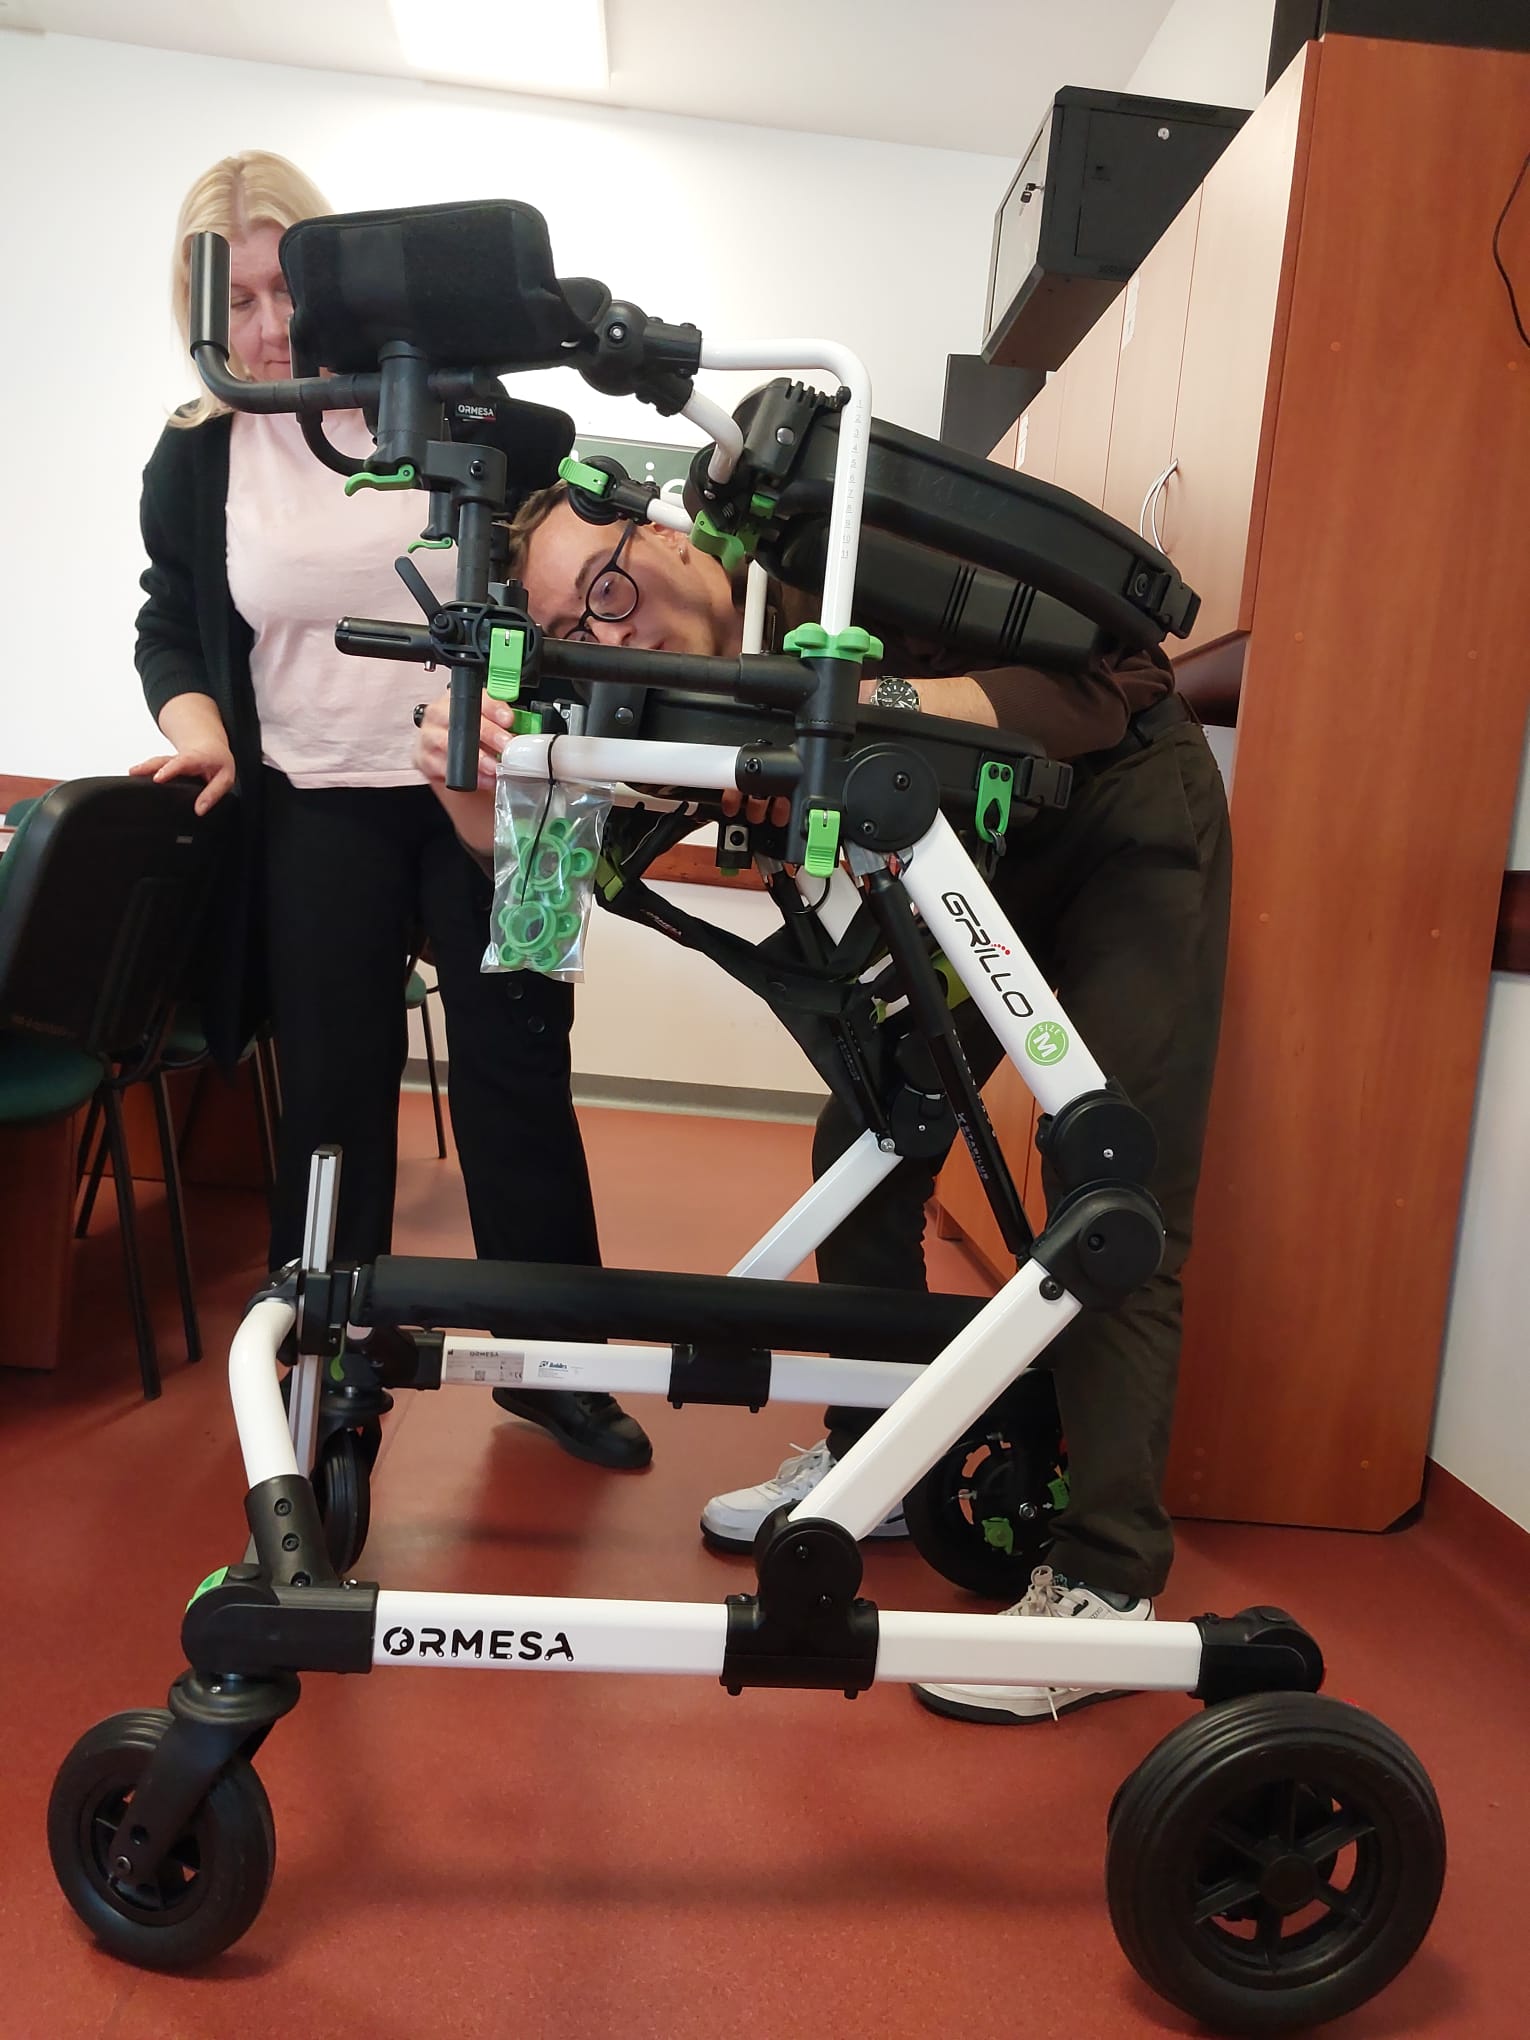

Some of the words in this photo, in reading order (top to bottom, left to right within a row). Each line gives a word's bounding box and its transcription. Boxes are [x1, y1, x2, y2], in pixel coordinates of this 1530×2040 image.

[458, 405, 494, 416] ORMESA
[941, 892, 1033, 1017] GRILLO
[1038, 1023, 1061, 1036] SIZE
[1033, 1031, 1057, 1058] M
[383, 1626, 574, 1661] ORMESA
